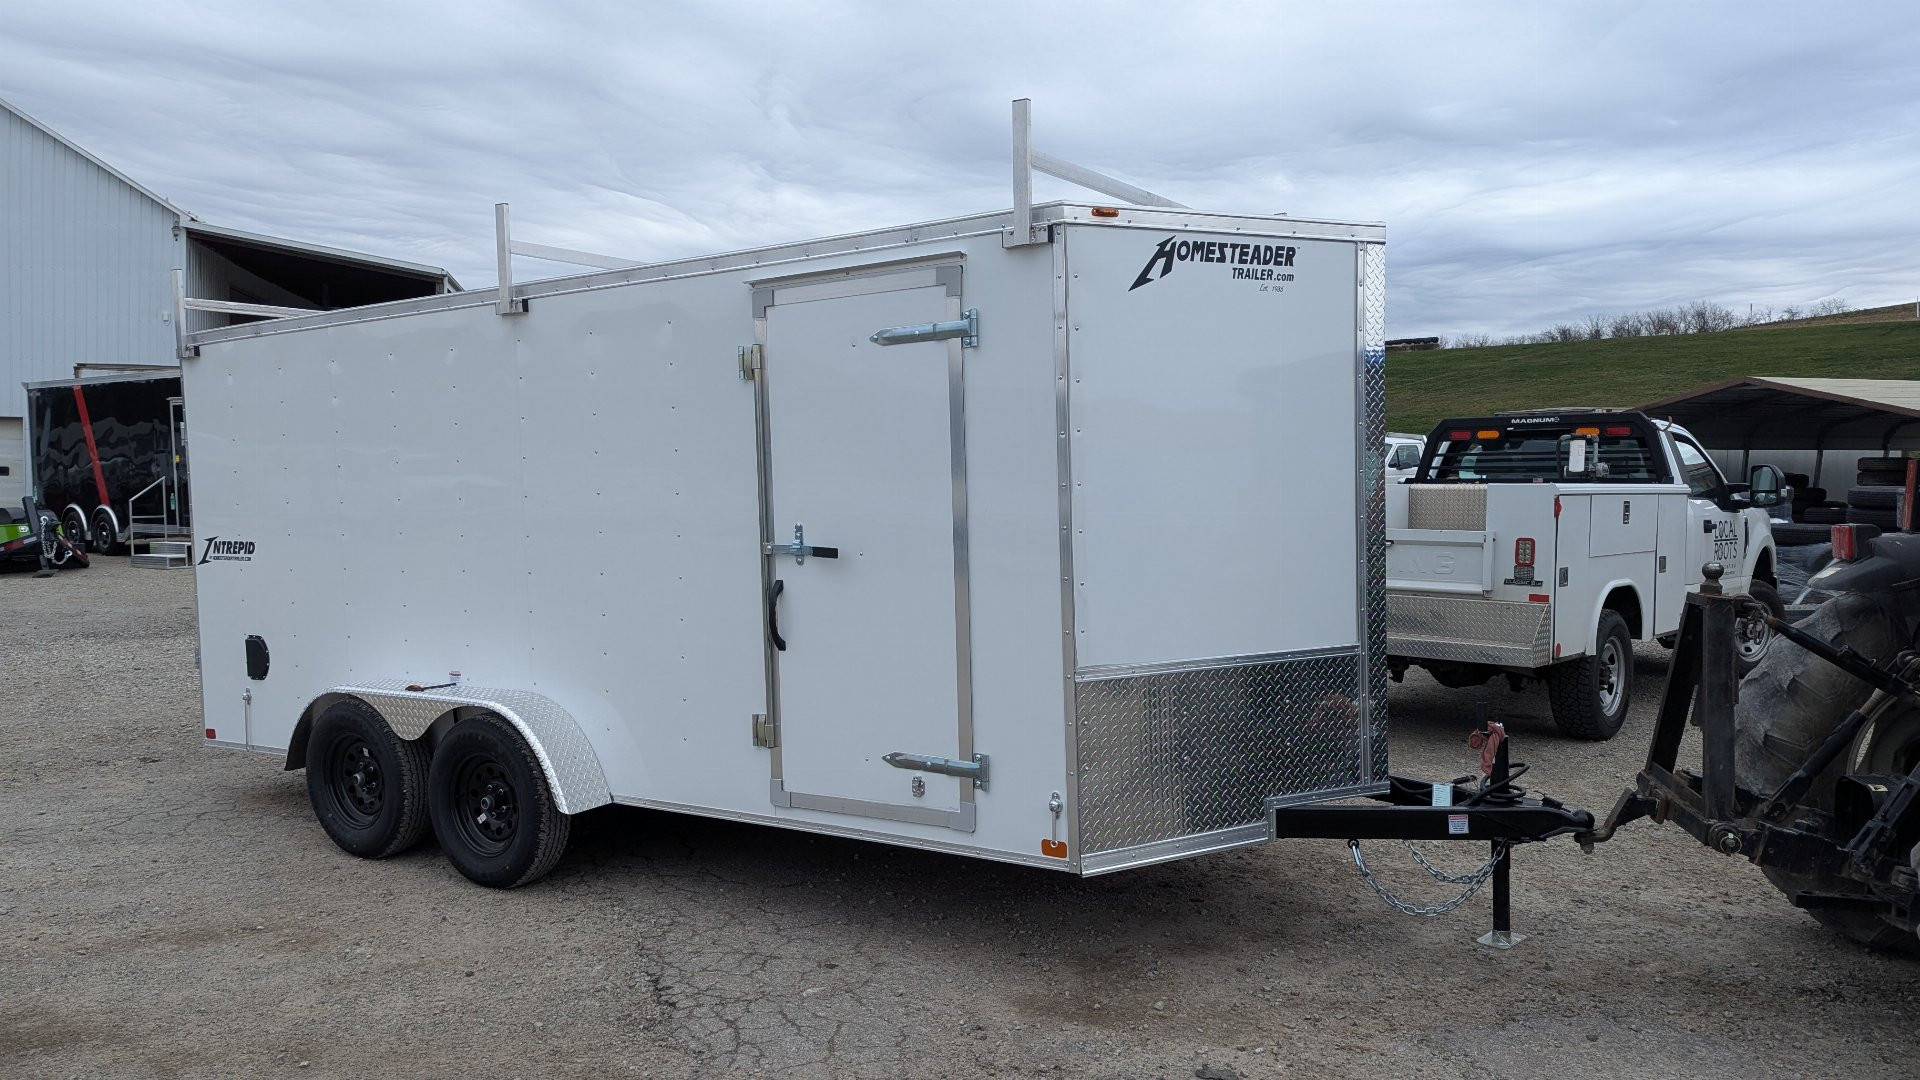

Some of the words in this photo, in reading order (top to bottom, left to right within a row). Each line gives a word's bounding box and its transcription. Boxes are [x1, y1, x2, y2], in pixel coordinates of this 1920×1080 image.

[1128, 235, 1296, 291] HOMESTEADER
[1232, 267, 1294, 281] TRAILER.com
[1714, 519, 1737, 539] LOCAL
[198, 536, 256, 565] INTREPID
[1714, 541, 1737, 561] ROOTS
